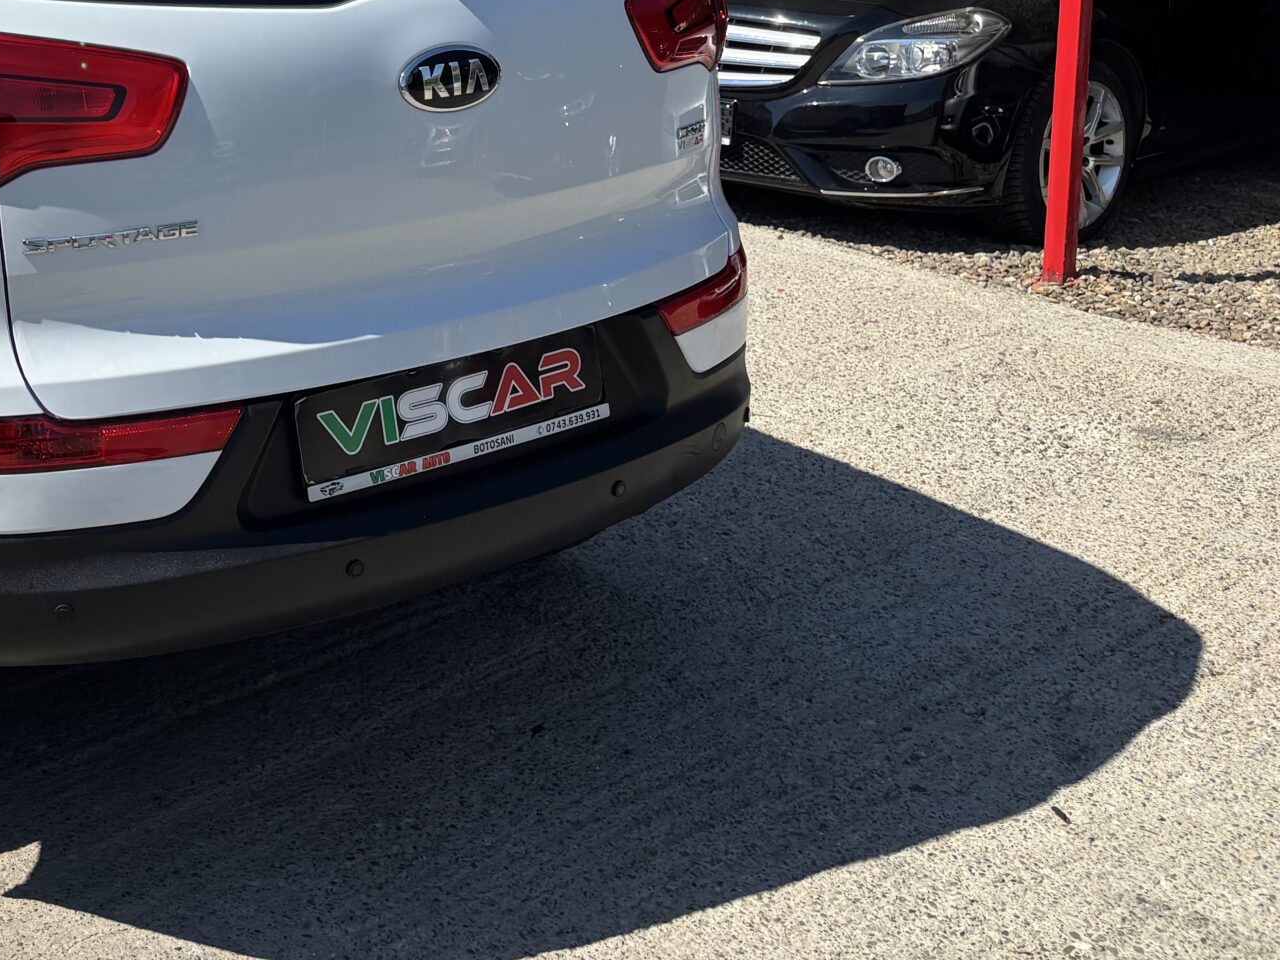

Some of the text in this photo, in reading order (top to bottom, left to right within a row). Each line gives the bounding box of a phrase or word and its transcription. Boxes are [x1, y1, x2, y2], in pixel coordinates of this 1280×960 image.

[418, 58, 490, 101] KIA
[22, 220, 201, 256] SPORTAGE
[316, 347, 586, 456] VISCAR
[545, 408, 602, 434] 0743.639.931
[473, 433, 516, 455] BOTOSANI
[369, 451, 452, 485] VISCAR AUTO
